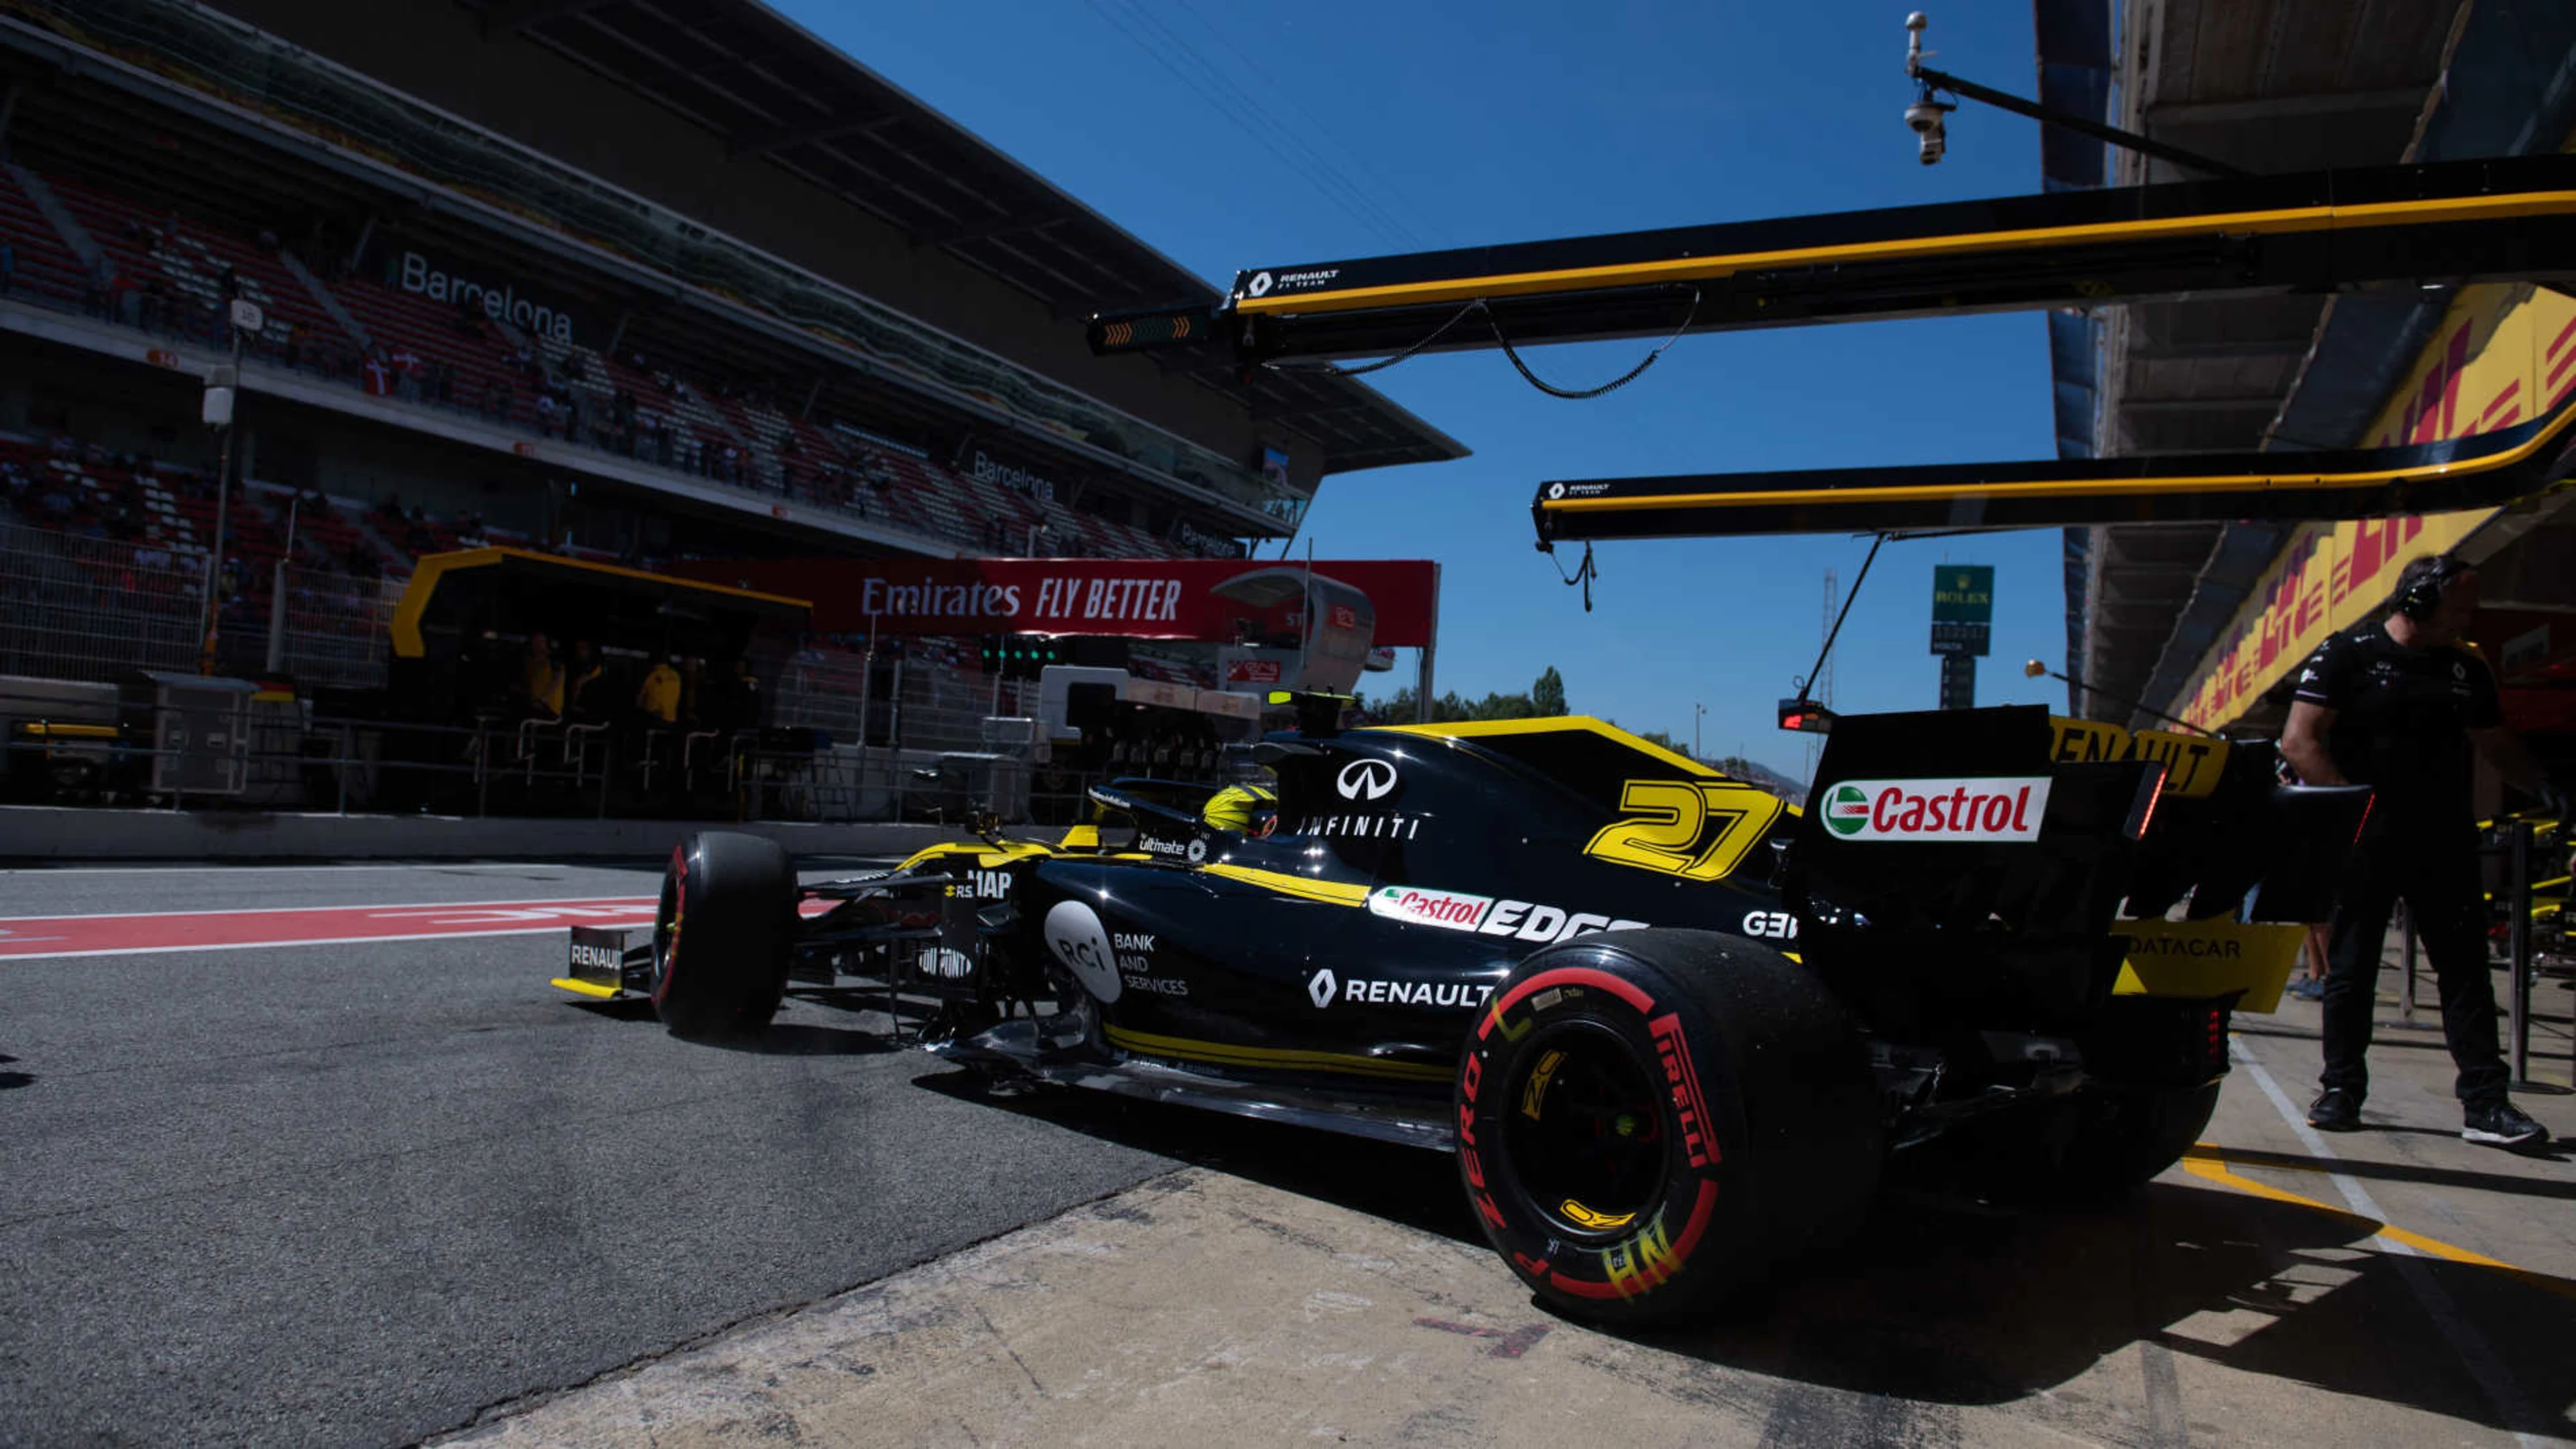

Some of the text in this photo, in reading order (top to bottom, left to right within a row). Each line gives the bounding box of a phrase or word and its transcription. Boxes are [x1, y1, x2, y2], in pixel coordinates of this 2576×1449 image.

[1280, 270, 1341, 282] RENAULT
[861, 576, 1182, 621] Emirates FLY BETTER
[1873, 786, 2032, 832] Castrol
[1296, 815, 1420, 840] INFINITI
[1583, 778, 1786, 882] 27
[1139, 836, 1185, 856] ultimate
[956, 884, 976, 899] RS
[1400, 891, 1486, 926] Castrol
[1114, 932, 1156, 953] BANK
[1118, 955, 1150, 972] AND
[1124, 975, 1190, 997] SERVICES
[1345, 979, 1496, 1008] RENAULT
[1648, 1012, 1723, 1168] PIRELLI
[1459, 1051, 1507, 1230] ZERO
